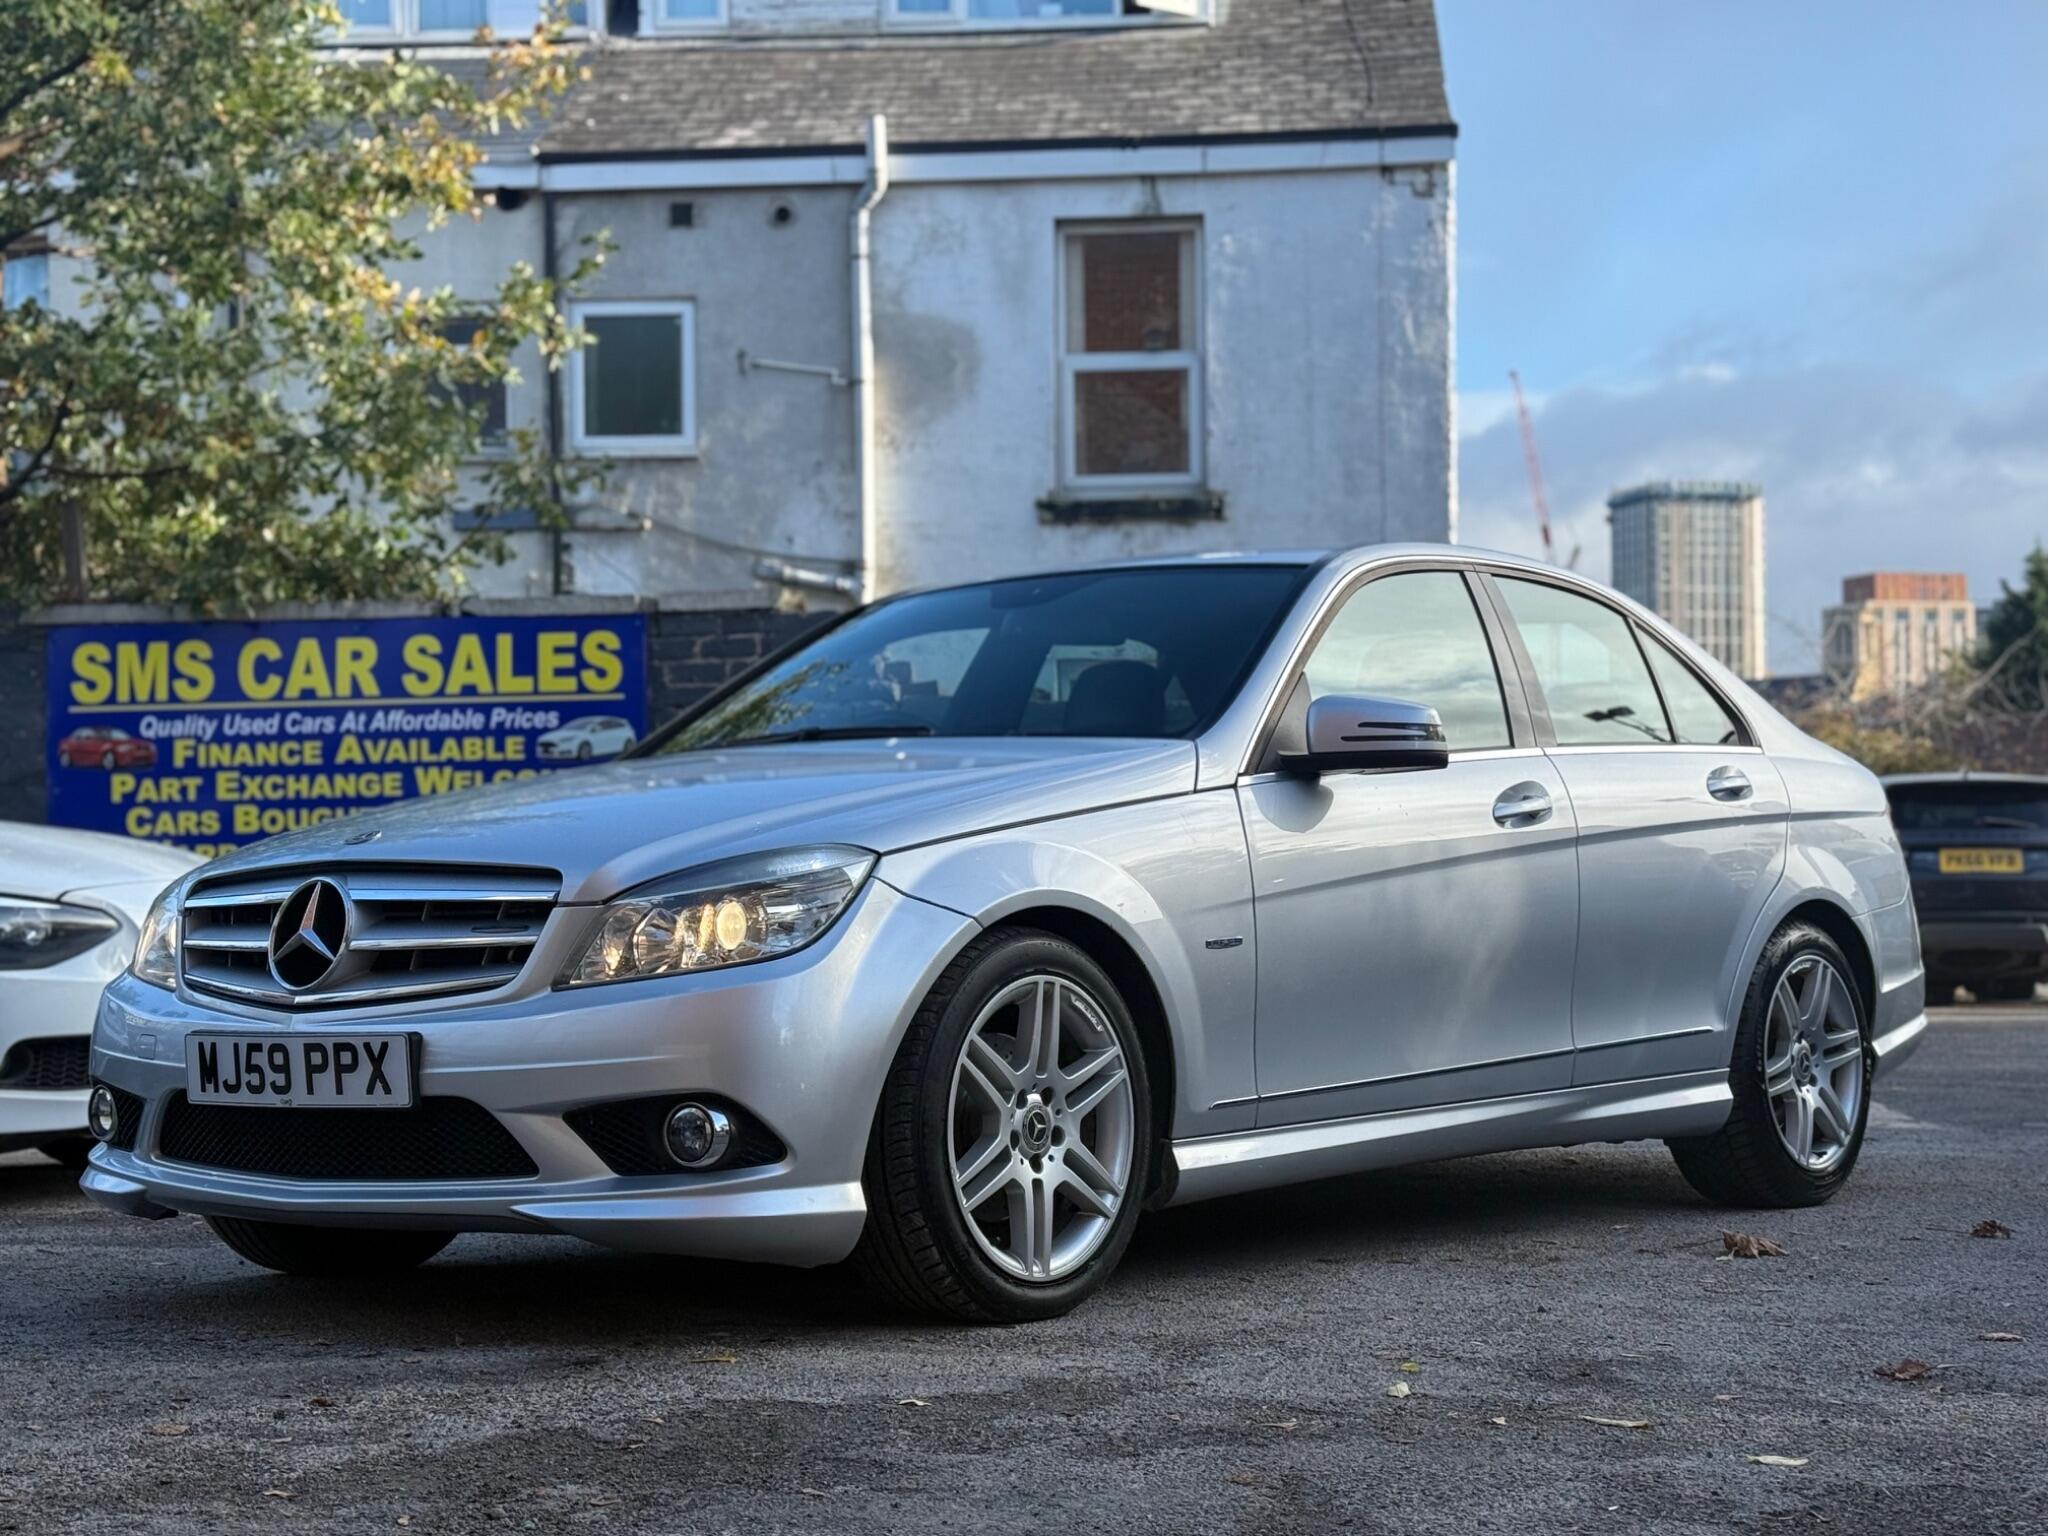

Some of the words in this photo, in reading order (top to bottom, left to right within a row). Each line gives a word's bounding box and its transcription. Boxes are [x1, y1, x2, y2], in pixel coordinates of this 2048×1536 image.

[69, 639, 215, 705] SMS
[237, 636, 381, 700] CAR
[401, 630, 624, 696] SALES
[139, 714, 217, 741] Quality
[222, 713, 280, 736] Used
[284, 711, 335, 735] Cars
[340, 710, 367, 733] At
[369, 708, 486, 732] Affordable
[489, 707, 560, 730] Prices
[173, 738, 324, 768] FINANCE
[334, 735, 526, 764] AVAILABLE
[110, 773, 202, 804] PART
[215, 769, 403, 802] EXCHANGE
[414, 766, 552, 797] WELCO
[125, 806, 221, 837] CARS
[233, 804, 361, 834] BOUG
[197, 1041, 292, 1095] MJ59
[303, 1041, 392, 1095] PPX
